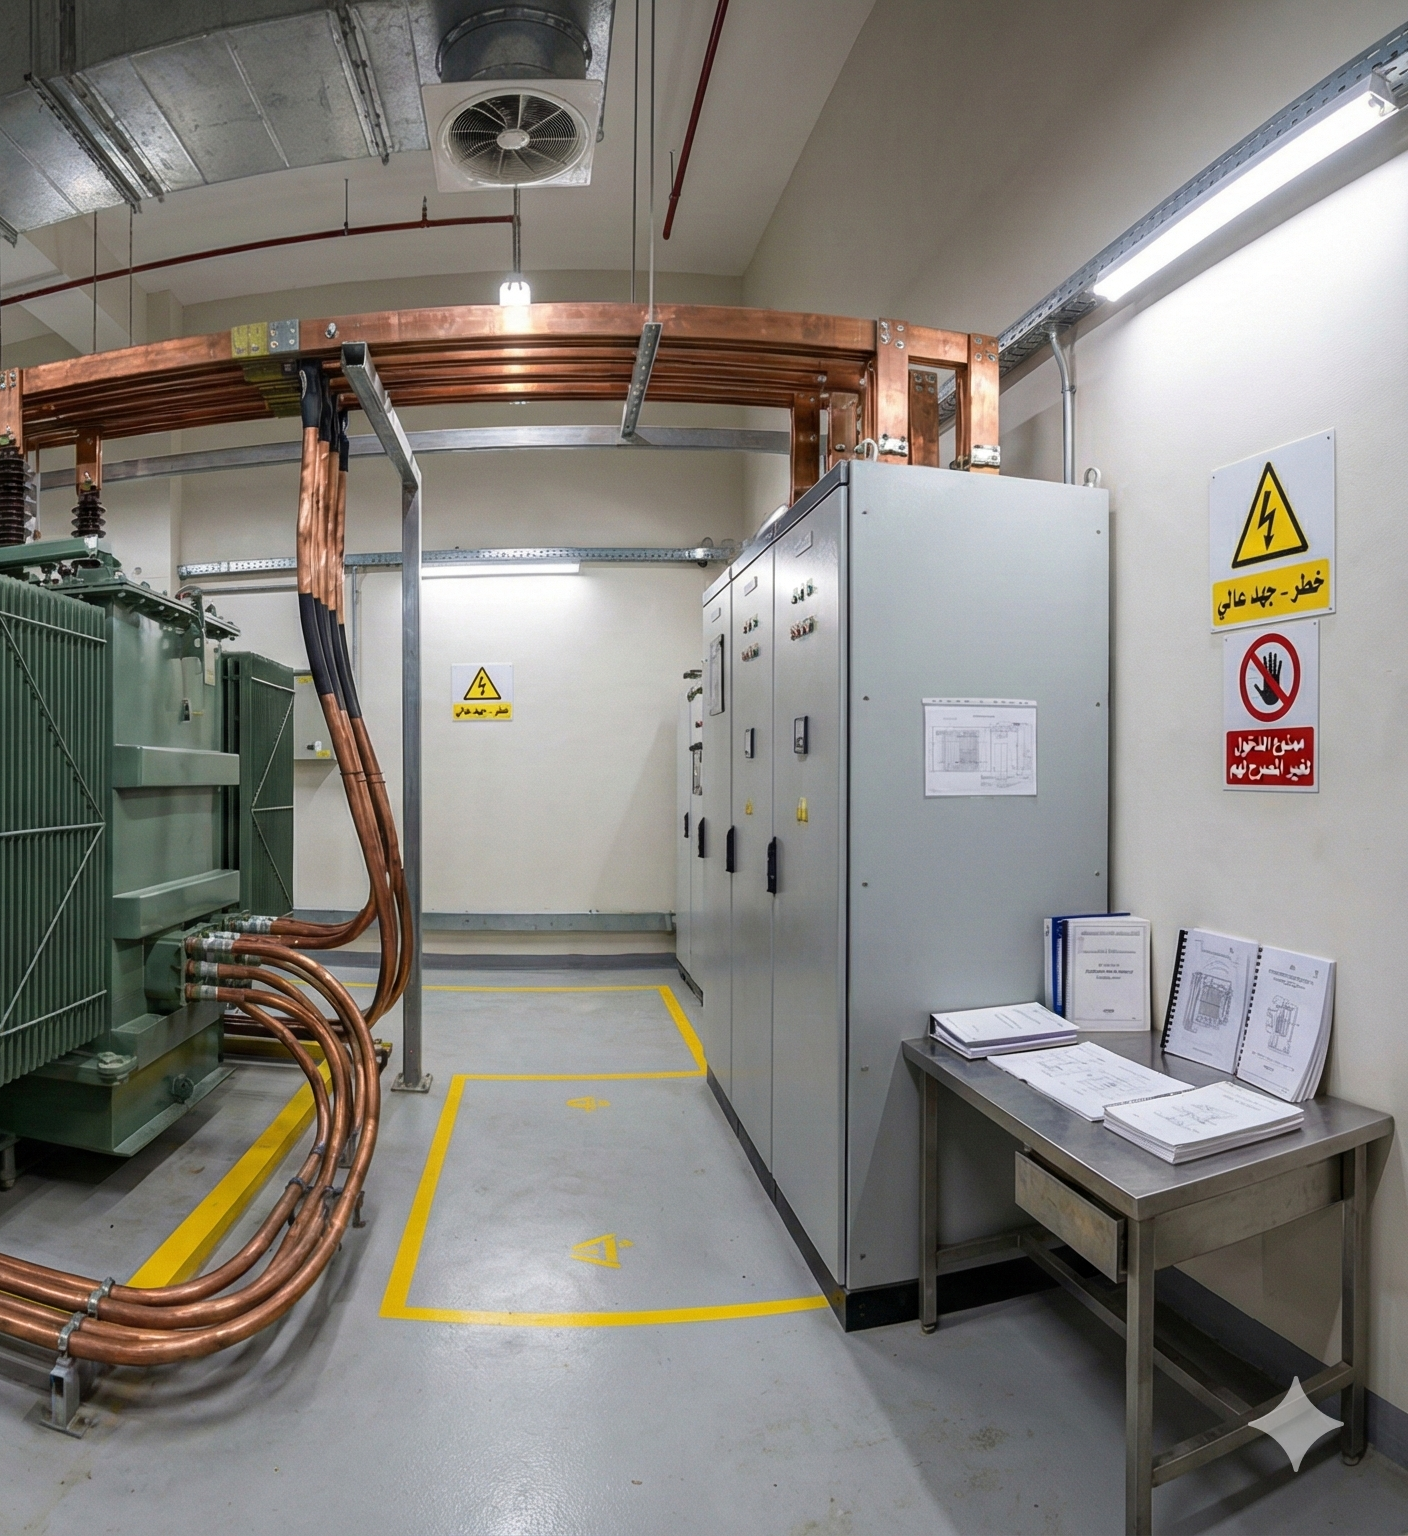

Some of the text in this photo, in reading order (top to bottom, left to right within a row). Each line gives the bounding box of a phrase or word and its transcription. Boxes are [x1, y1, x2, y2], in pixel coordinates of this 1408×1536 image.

[1250, 585, 1277, 608] جهد
[1290, 570, 1325, 603] خطر
[1217, 588, 1247, 621] عالي
